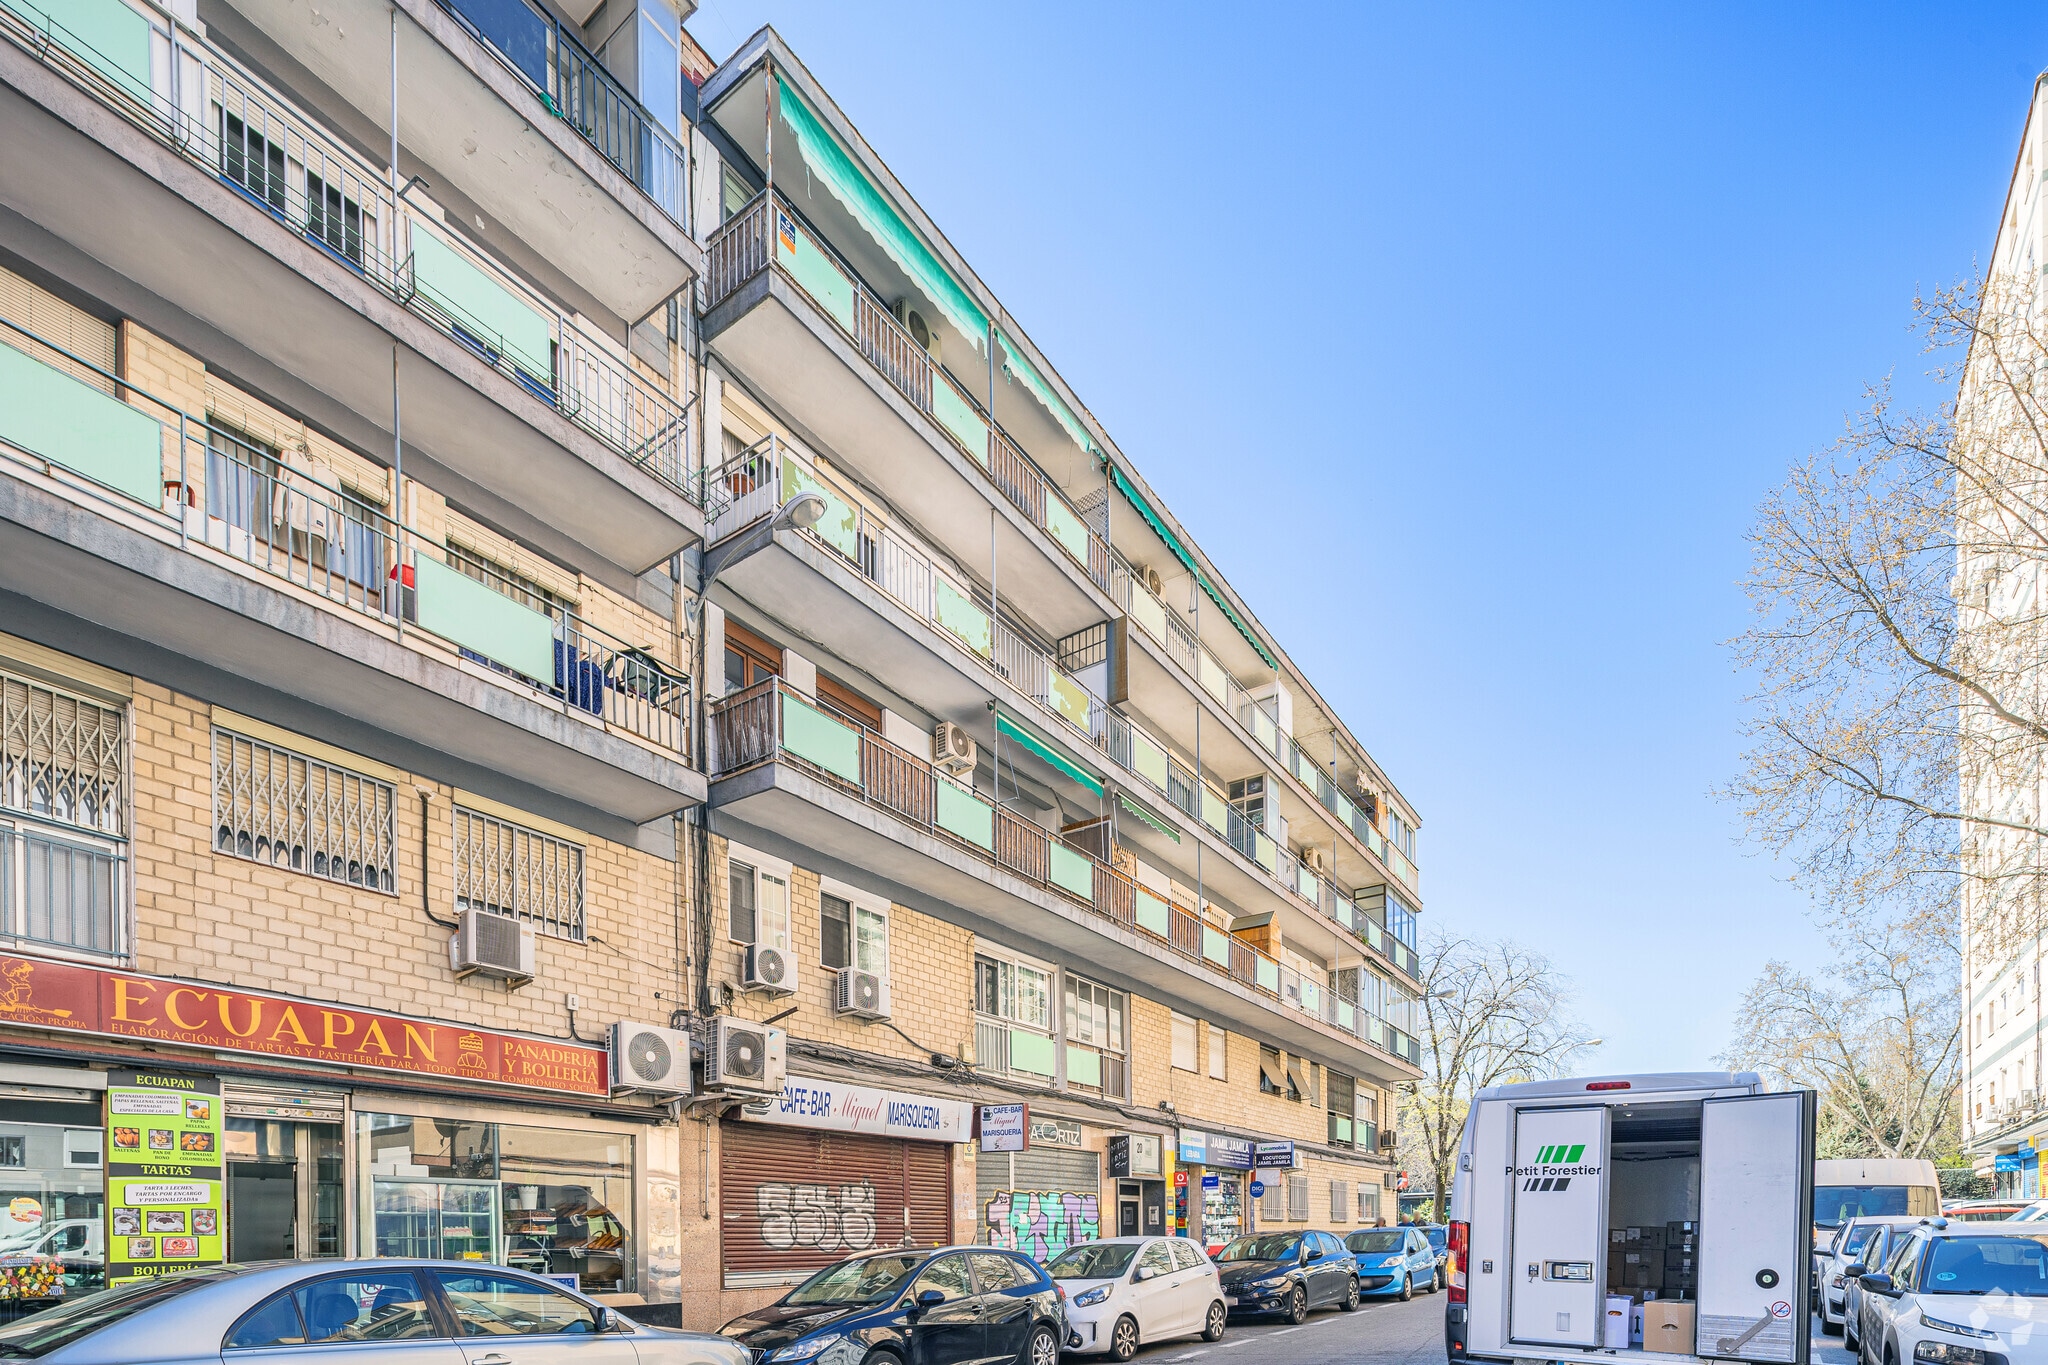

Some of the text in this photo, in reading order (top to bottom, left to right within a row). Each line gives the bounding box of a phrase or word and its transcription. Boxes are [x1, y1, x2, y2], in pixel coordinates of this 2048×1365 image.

[48, 1017, 87, 1029] PROPIA
[111, 977, 438, 1062] ECUAPAN
[111, 1023, 599, 1094] ELABORACIÓN DE TARTAS Y PASTELERÍA PARA TODO TIPO DE COMPROMISO SOCIAL
[504, 1041, 598, 1069] PANADERÍA
[504, 1058, 598, 1085] Y BOLLERÍA
[136, 1075, 195, 1089] ECUAPAN
[780, 1086, 940, 1130] CAFE-BAR Miguel MARISQUERIA
[993, 1106, 1023, 1114] CAFE-BAR
[990, 1116, 1018, 1128] Miguel
[982, 1128, 1022, 1137] MARISQUERIA
[1136, 1142, 1143, 1154] 20
[1210, 1137, 1250, 1154] JAMIL JAMILA
[141, 1165, 192, 1176] TARTAS
[1505, 1165, 1602, 1176] Petit Forestier
